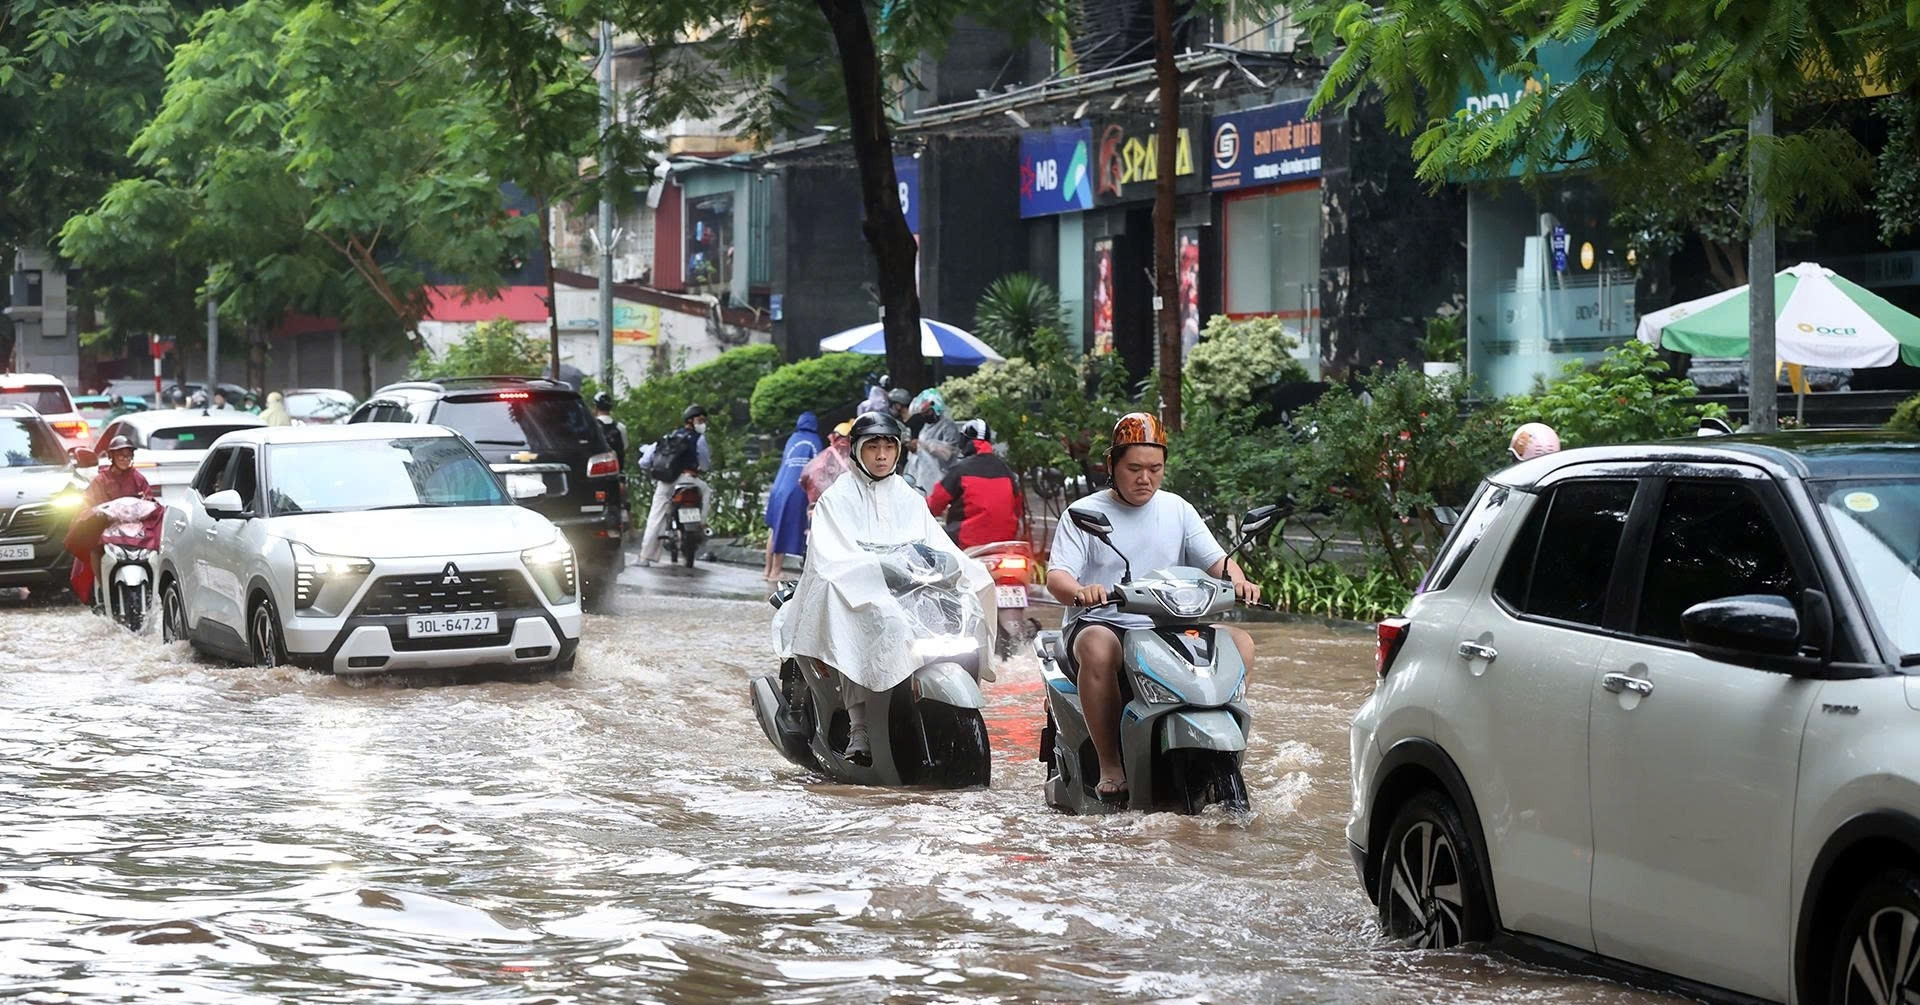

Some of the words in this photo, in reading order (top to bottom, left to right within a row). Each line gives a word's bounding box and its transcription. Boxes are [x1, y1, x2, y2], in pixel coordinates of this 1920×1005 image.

[1121, 128, 1194, 184] SPAA
[1036, 159, 1057, 192] MB
[898, 181, 909, 215] B
[1816, 326, 1857, 336] OCB
[416, 617, 490, 633] 30L-647.27
